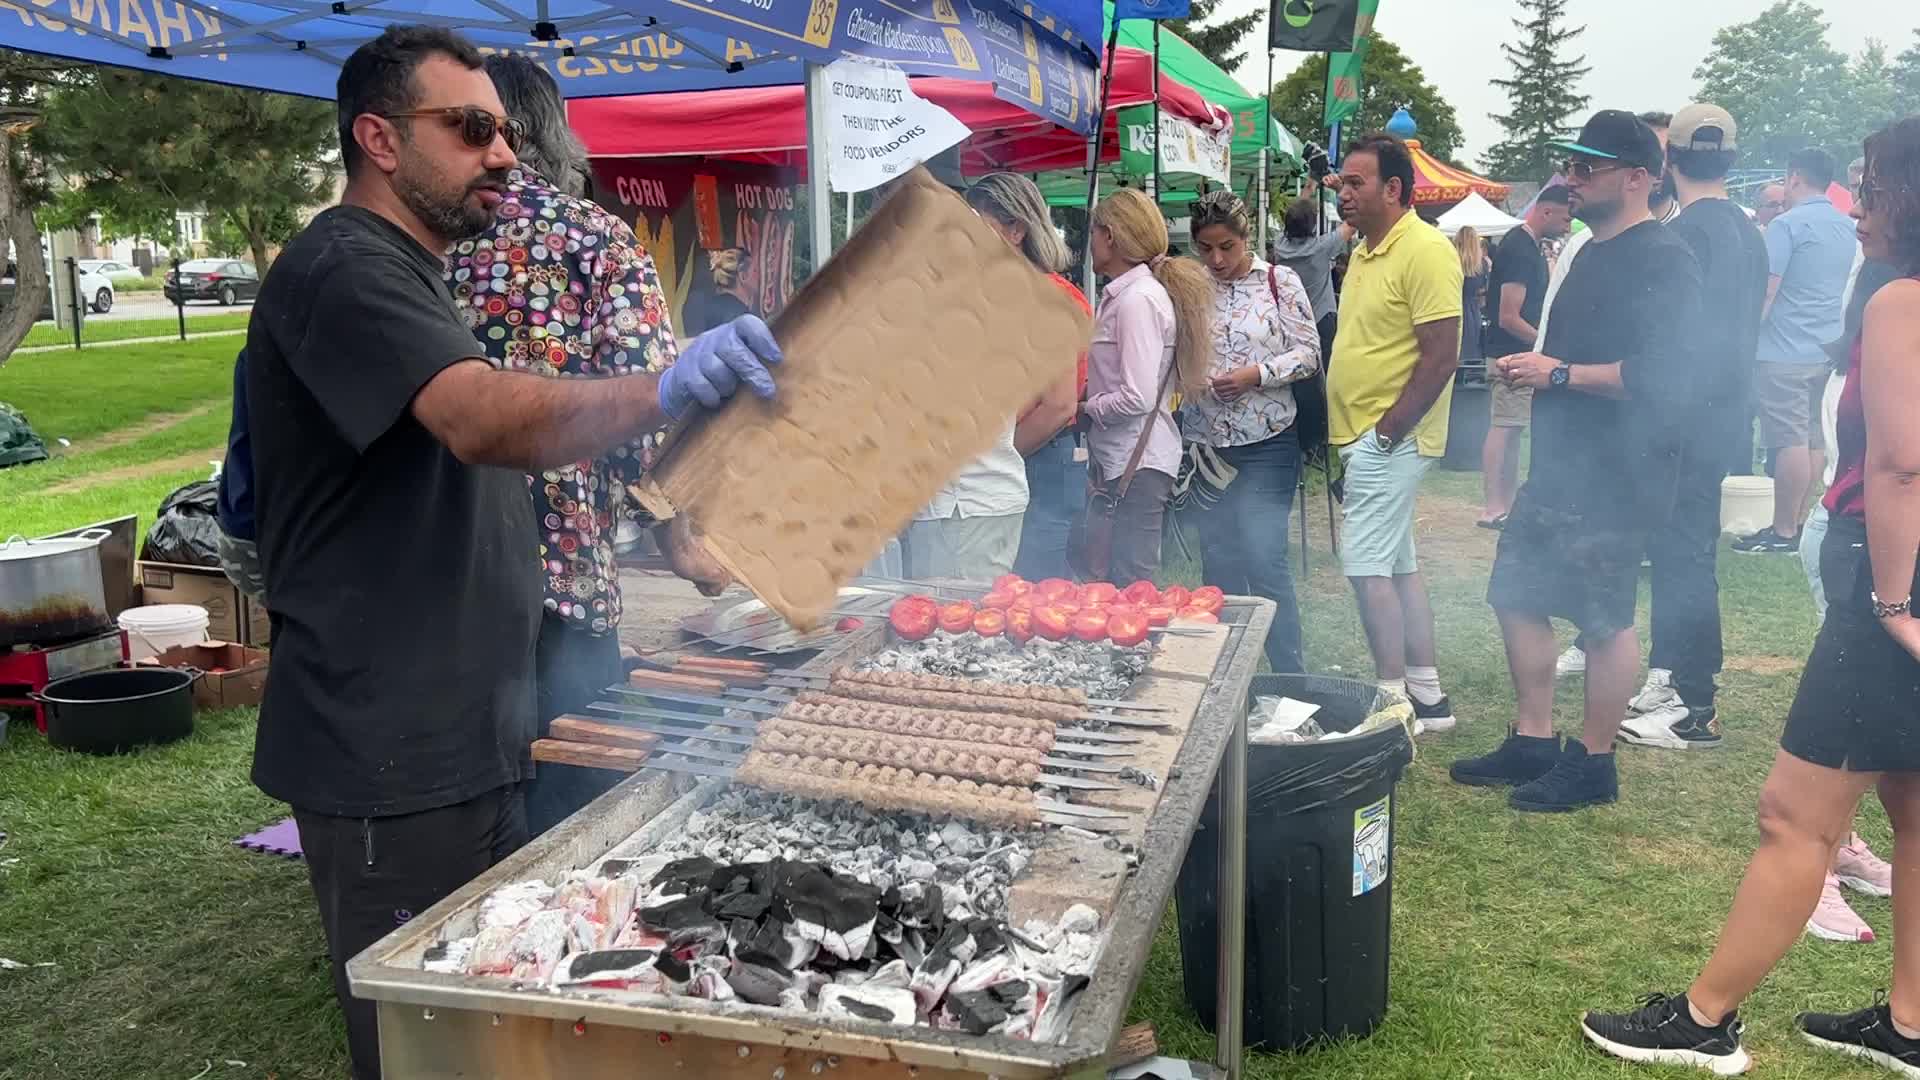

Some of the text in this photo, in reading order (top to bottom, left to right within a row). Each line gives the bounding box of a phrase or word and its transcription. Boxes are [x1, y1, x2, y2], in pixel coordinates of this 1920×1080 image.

[844, 84, 879, 102] COUPONS
[842, 114, 863, 129] THEN
[880, 115, 906, 131] THE
[843, 125, 926, 160] FOOD VENDORS
[616, 175, 669, 208] CORN
[735, 183, 794, 210] HOT DOG
